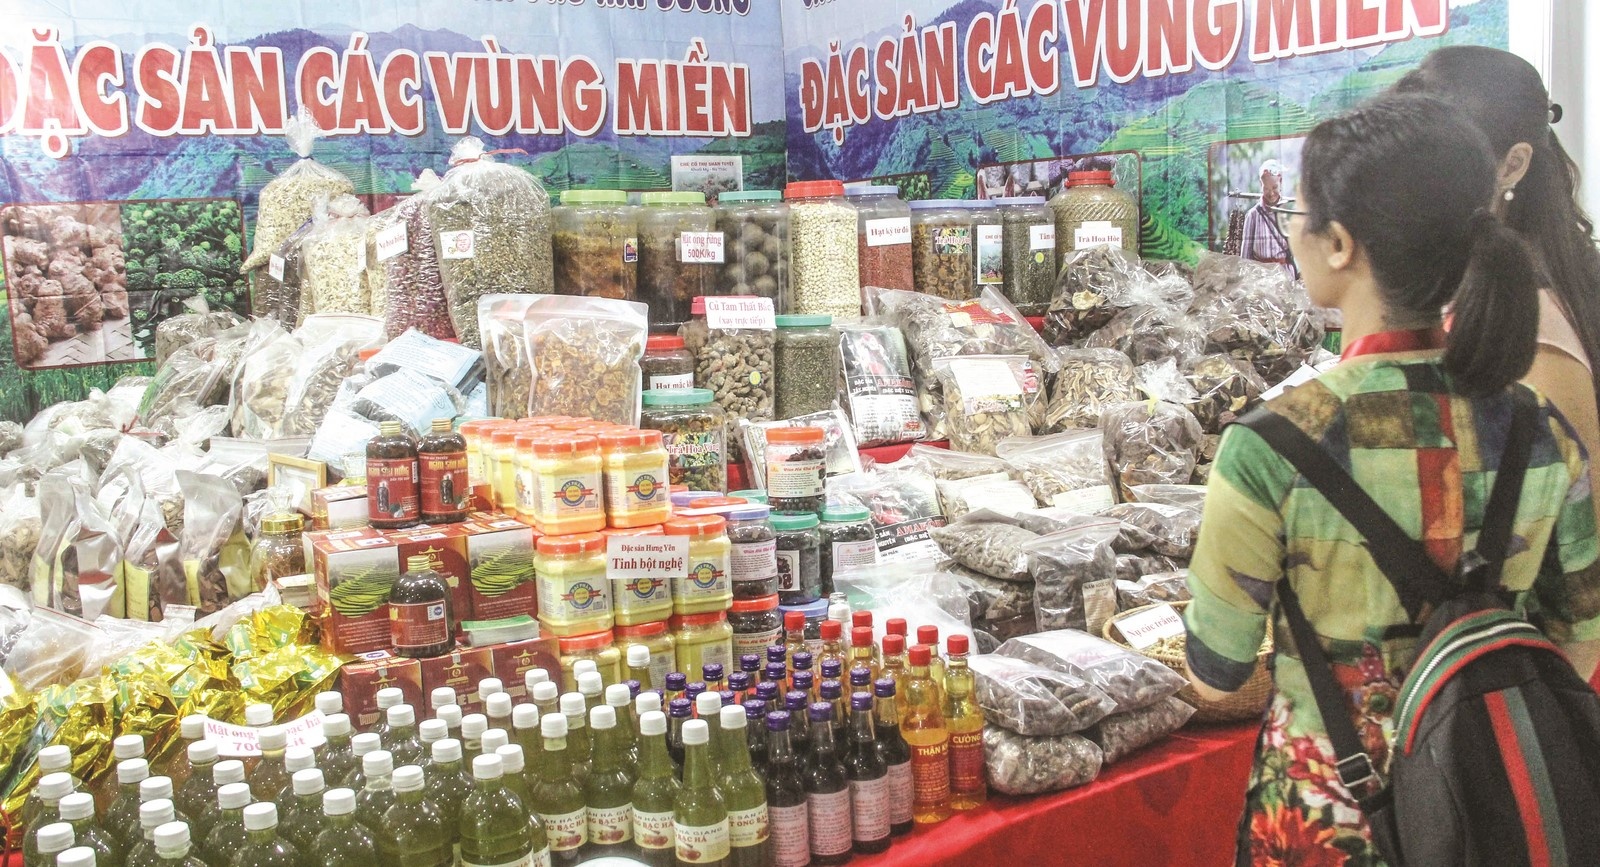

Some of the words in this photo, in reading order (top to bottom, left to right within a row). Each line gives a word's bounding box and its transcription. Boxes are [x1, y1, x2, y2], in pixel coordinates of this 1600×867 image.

[799, 40, 871, 146] ĐẶC
[874, 10, 957, 120] SẢN
[966, 0, 1060, 105] CÁC
[132, 24, 287, 136] SẢN
[294, 32, 425, 137] CÁC
[424, 35, 607, 136] VÙNG
[613, 37, 751, 137] MIỀN
[688, 248, 716, 260] 500K/kg
[708, 300, 720, 310] Củ
[720, 302, 738, 310] Tam
[622, 544, 634, 553] Đặc
[646, 544, 662, 552] Hưng
[612, 558, 637, 570] Tinh
[640, 557, 656, 572] bột
[658, 556, 682, 572] nghệ
[1142, 622, 1155, 633] cúc
[207, 722, 230, 738] Mật
[232, 730, 254, 741] ong
[952, 734, 981, 744] CƯỜNG
[693, 827, 722, 836] GIANG
